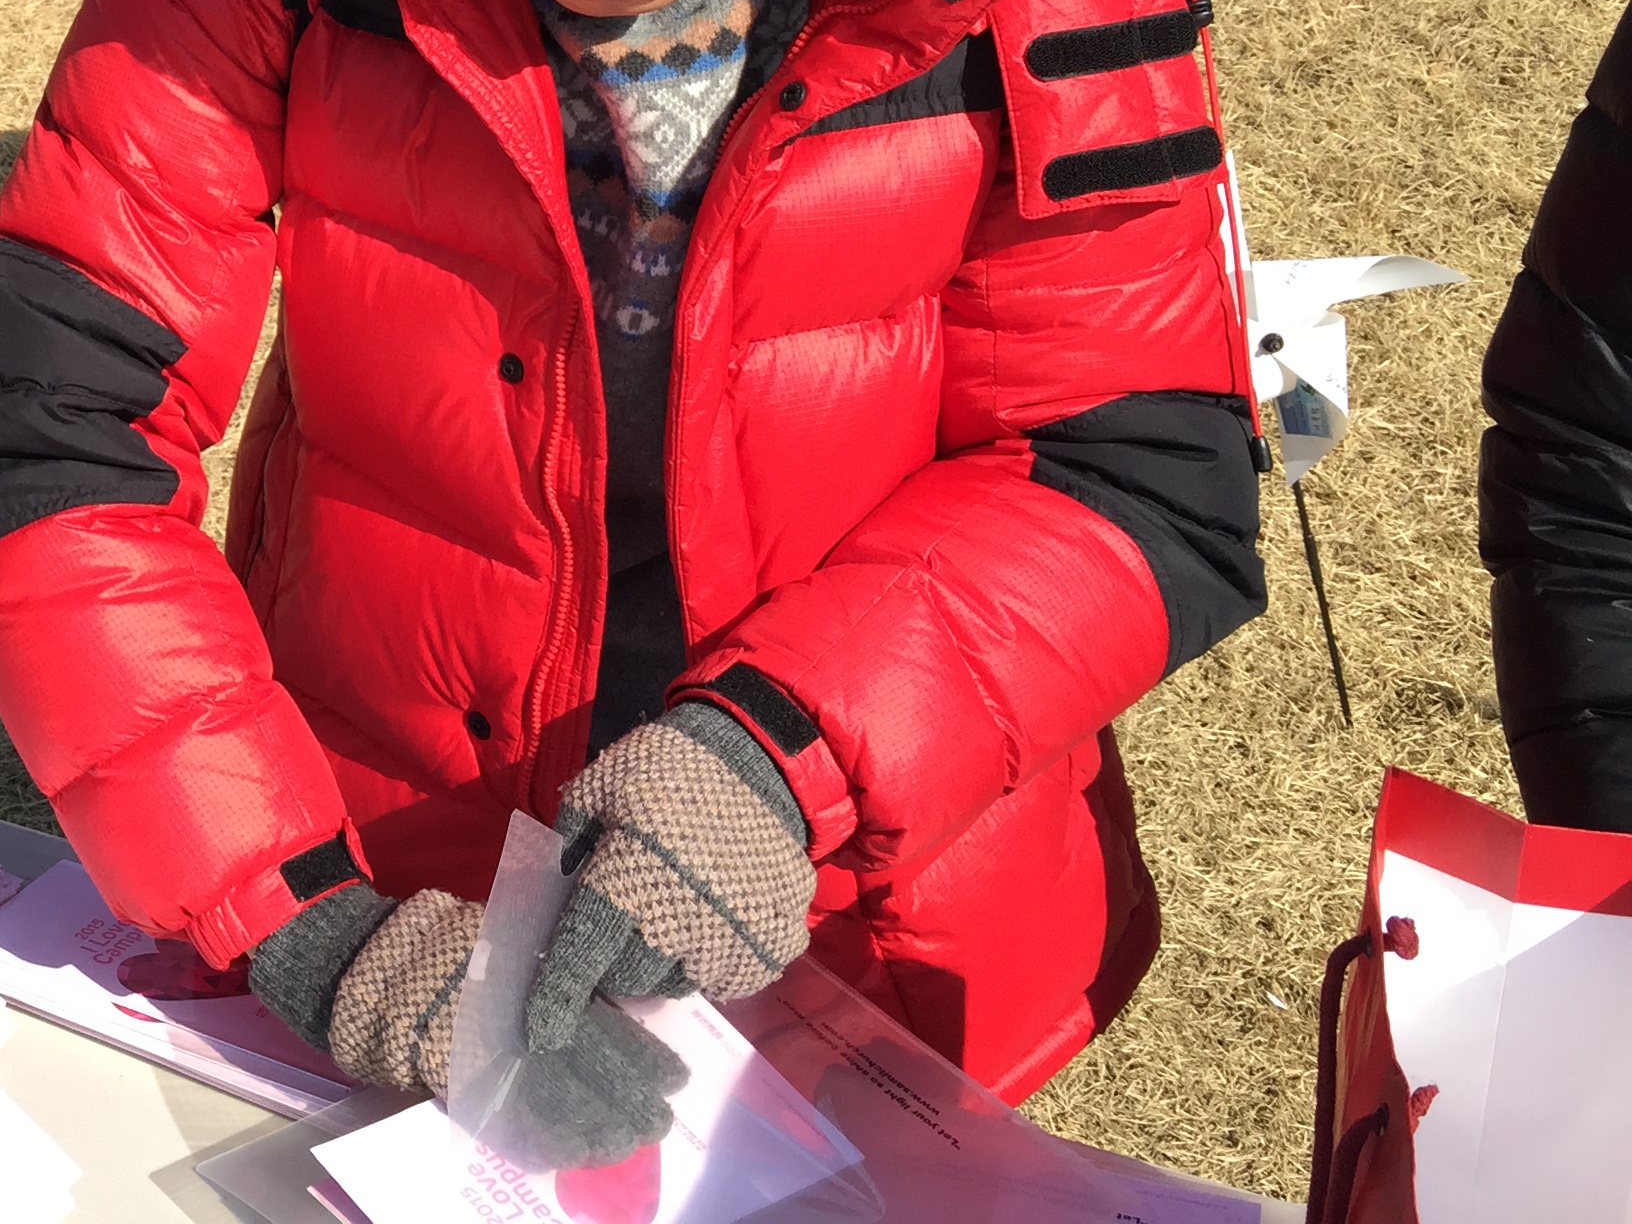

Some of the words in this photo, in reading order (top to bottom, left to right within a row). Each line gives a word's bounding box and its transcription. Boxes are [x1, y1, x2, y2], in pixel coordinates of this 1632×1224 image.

[75, 918, 105, 940] 2015
[92, 927, 145, 964] Camp
[840, 1051, 870, 1076] shine
[870, 1076, 884, 1089] so
[884, 1088, 910, 1110] light
[912, 1110, 940, 1130] your
[467, 1162, 524, 1220] Love
[475, 1143, 563, 1224] ampus
